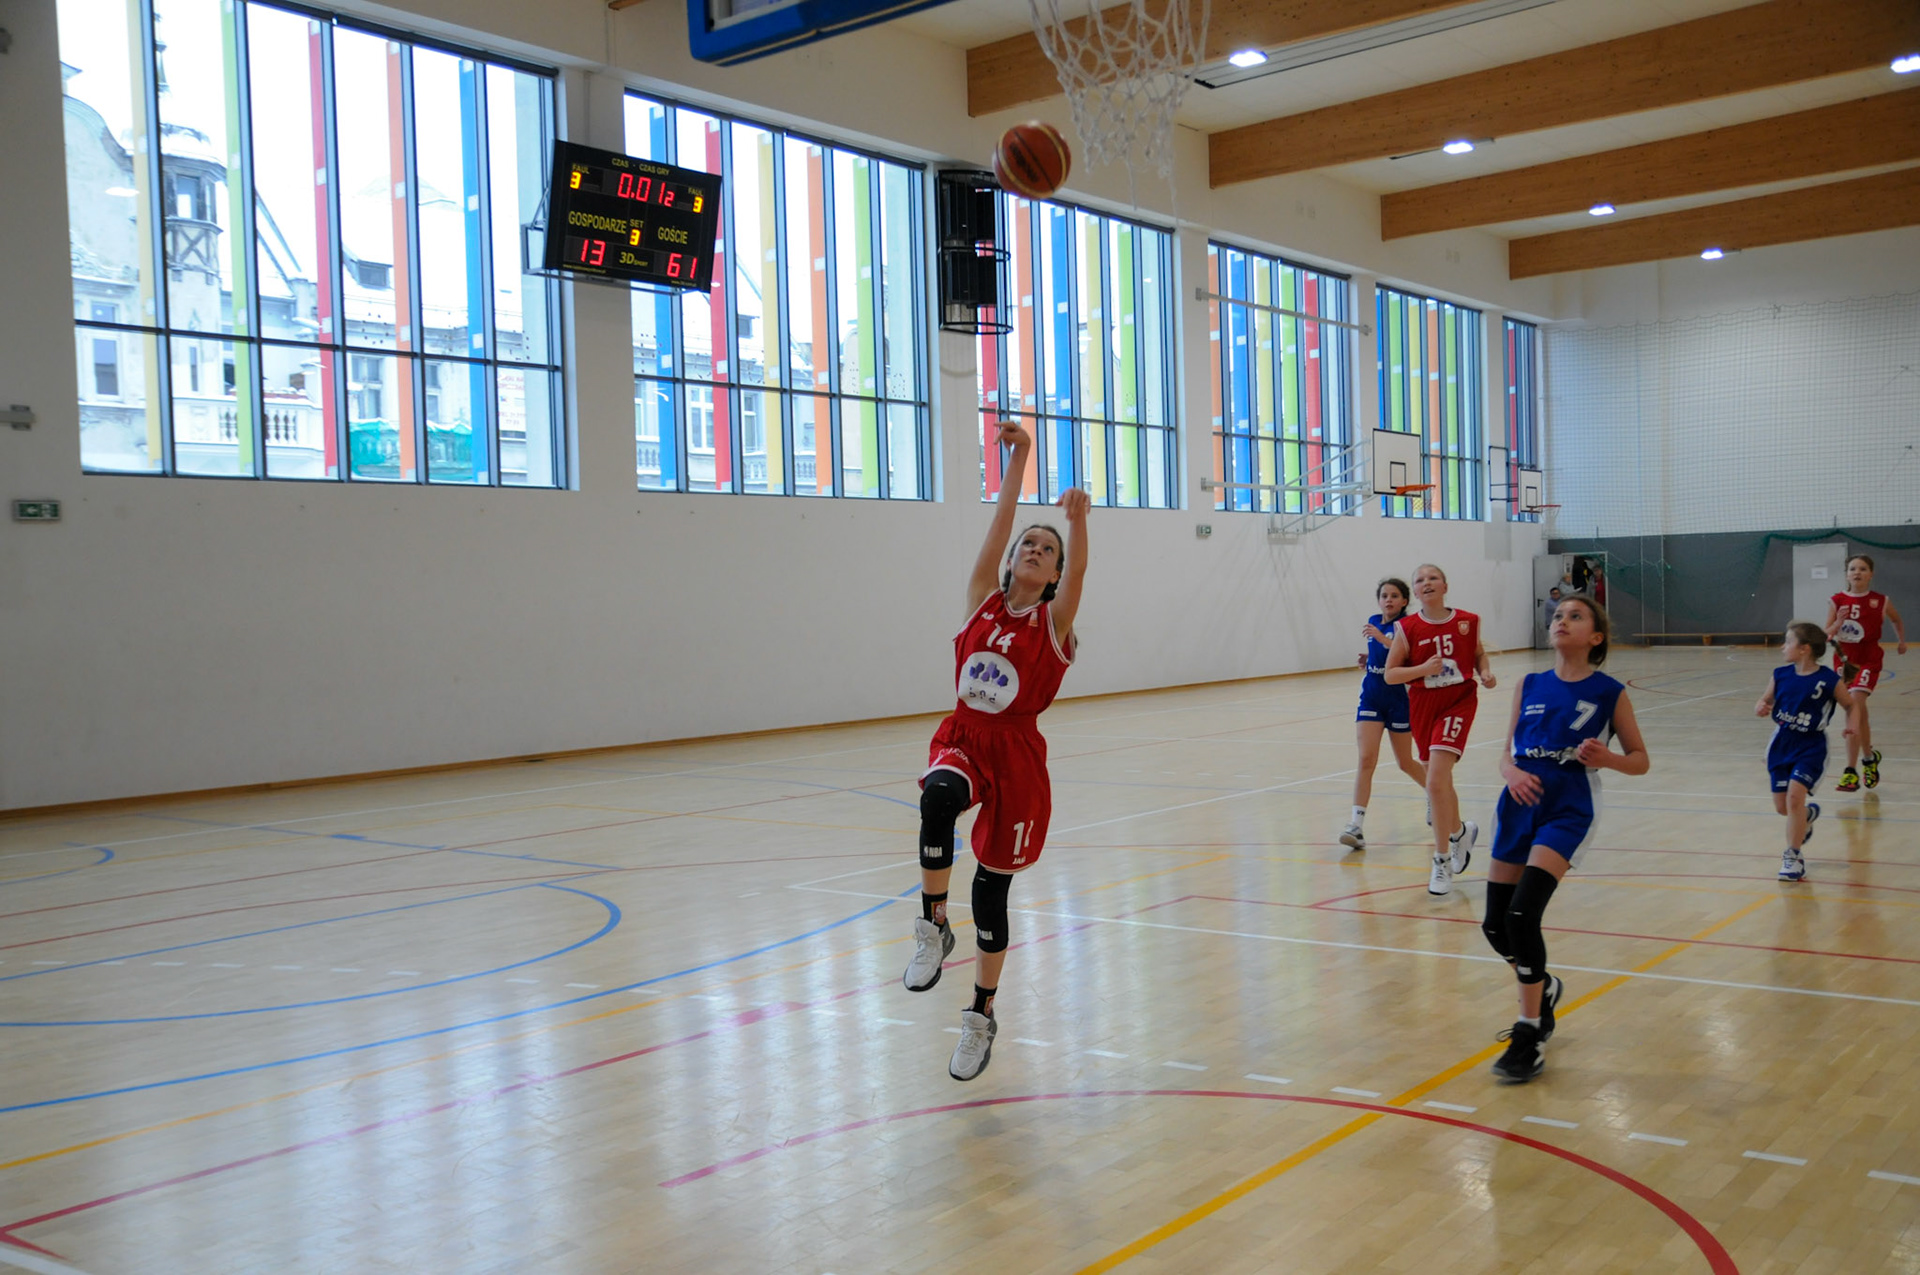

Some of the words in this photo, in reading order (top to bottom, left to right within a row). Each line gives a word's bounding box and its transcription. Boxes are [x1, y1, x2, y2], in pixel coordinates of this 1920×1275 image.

[611, 157, 629, 168] CZAS
[639, 163, 656, 174] CZAS
[656, 166, 670, 176] GRY
[570, 172, 581, 189] 3
[692, 196, 704, 213] 3
[568, 210, 627, 234] GOSPODARZE
[629, 219, 644, 229] SET
[629, 229, 641, 246] 3
[657, 225, 689, 245] GOŚCIE
[580, 239, 606, 266] 13
[666, 252, 698, 279] 61
[1850, 603, 1861, 620] 5
[986, 622, 1017, 655] 14
[1432, 634, 1454, 657] 15
[1811, 680, 1826, 699] 5
[1569, 699, 1598, 731] 7
[1443, 716, 1464, 738] 15
